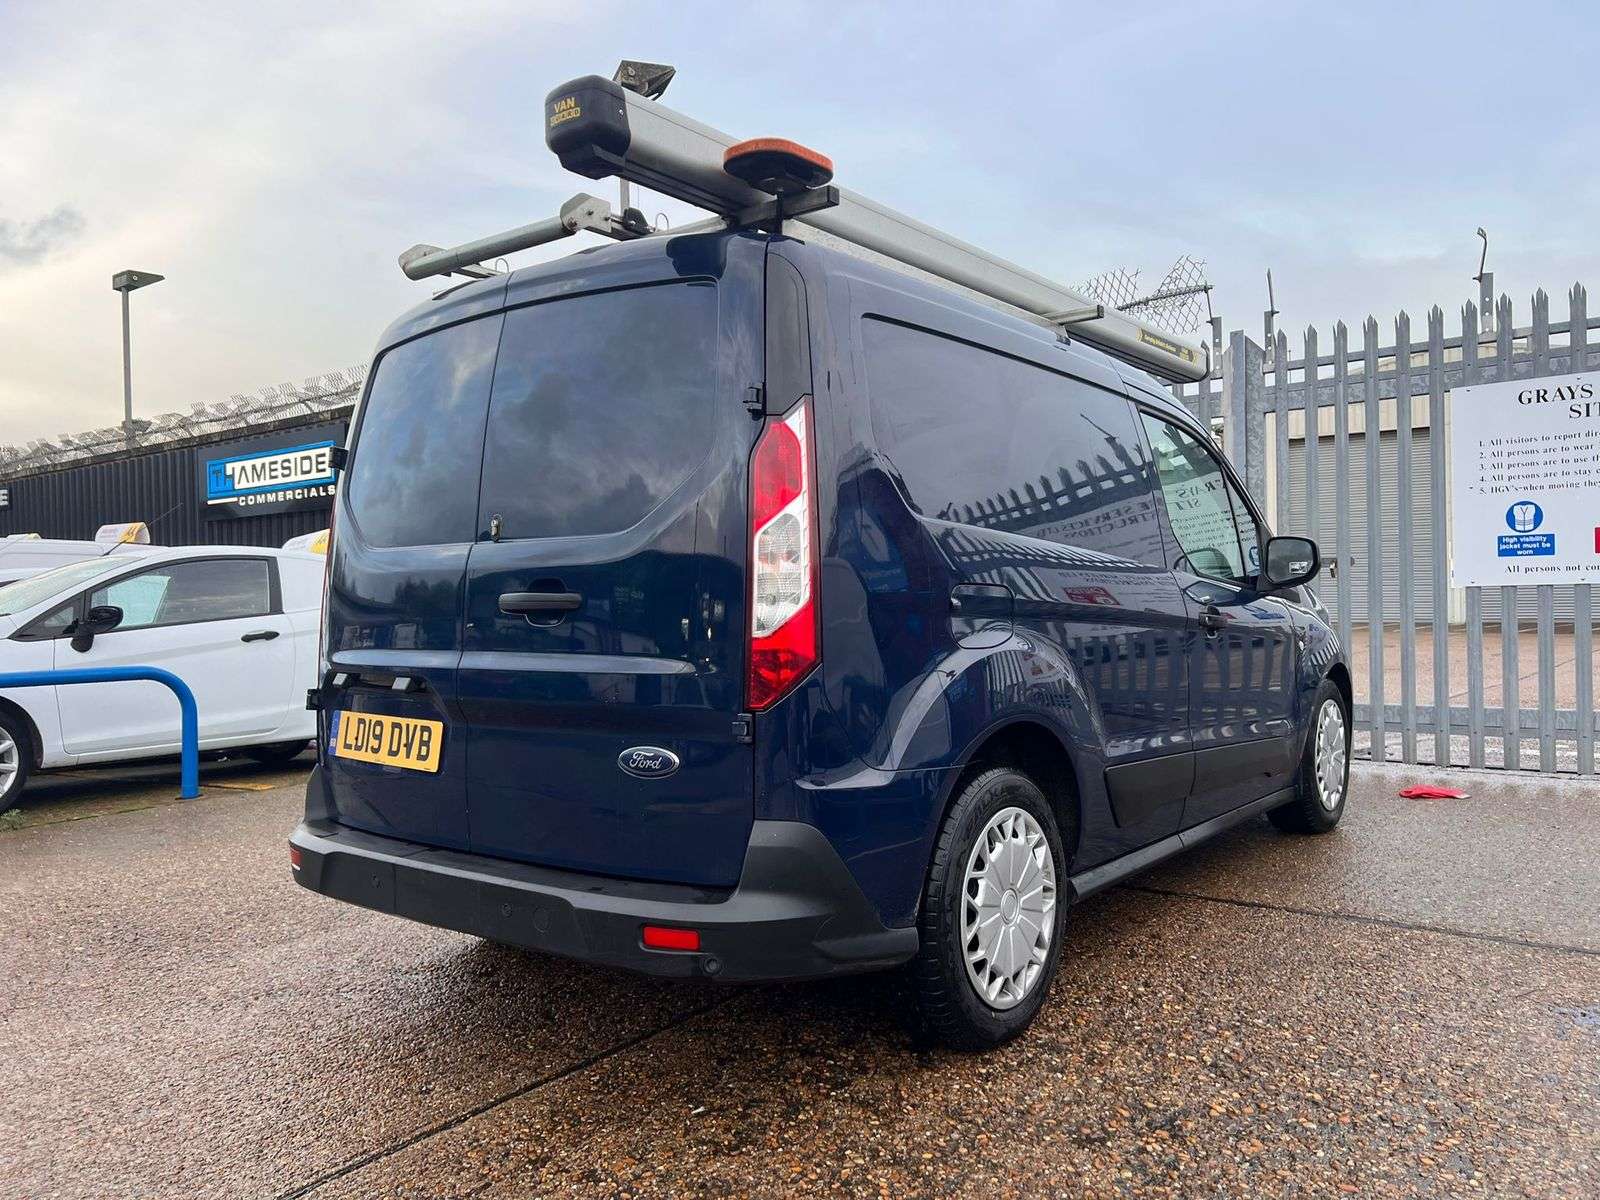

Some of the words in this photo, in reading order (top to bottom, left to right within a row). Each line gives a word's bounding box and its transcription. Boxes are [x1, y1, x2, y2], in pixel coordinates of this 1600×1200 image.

[554, 96, 576, 113] VAN
[1518, 384, 1593, 405] GRAYS
[1490, 438, 1502, 446] All
[1506, 436, 1538, 445] visitors
[1554, 432, 1581, 441] report
[1585, 430, 1600, 438] dir
[1507, 449, 1540, 458] persons
[210, 452, 327, 491] THAMESIDE
[1507, 461, 1540, 470] persons
[1508, 473, 1540, 482] persons
[1549, 481, 1580, 489] moving
[1584, 480, 1600, 488] the
[239, 485, 336, 506] COMMERCIALS
[1505, 565, 1520, 573] All
[1525, 565, 1561, 574] persons
[343, 716, 384, 754] LD19
[388, 722, 432, 762] DVB
[630, 751, 662, 769] Ford
